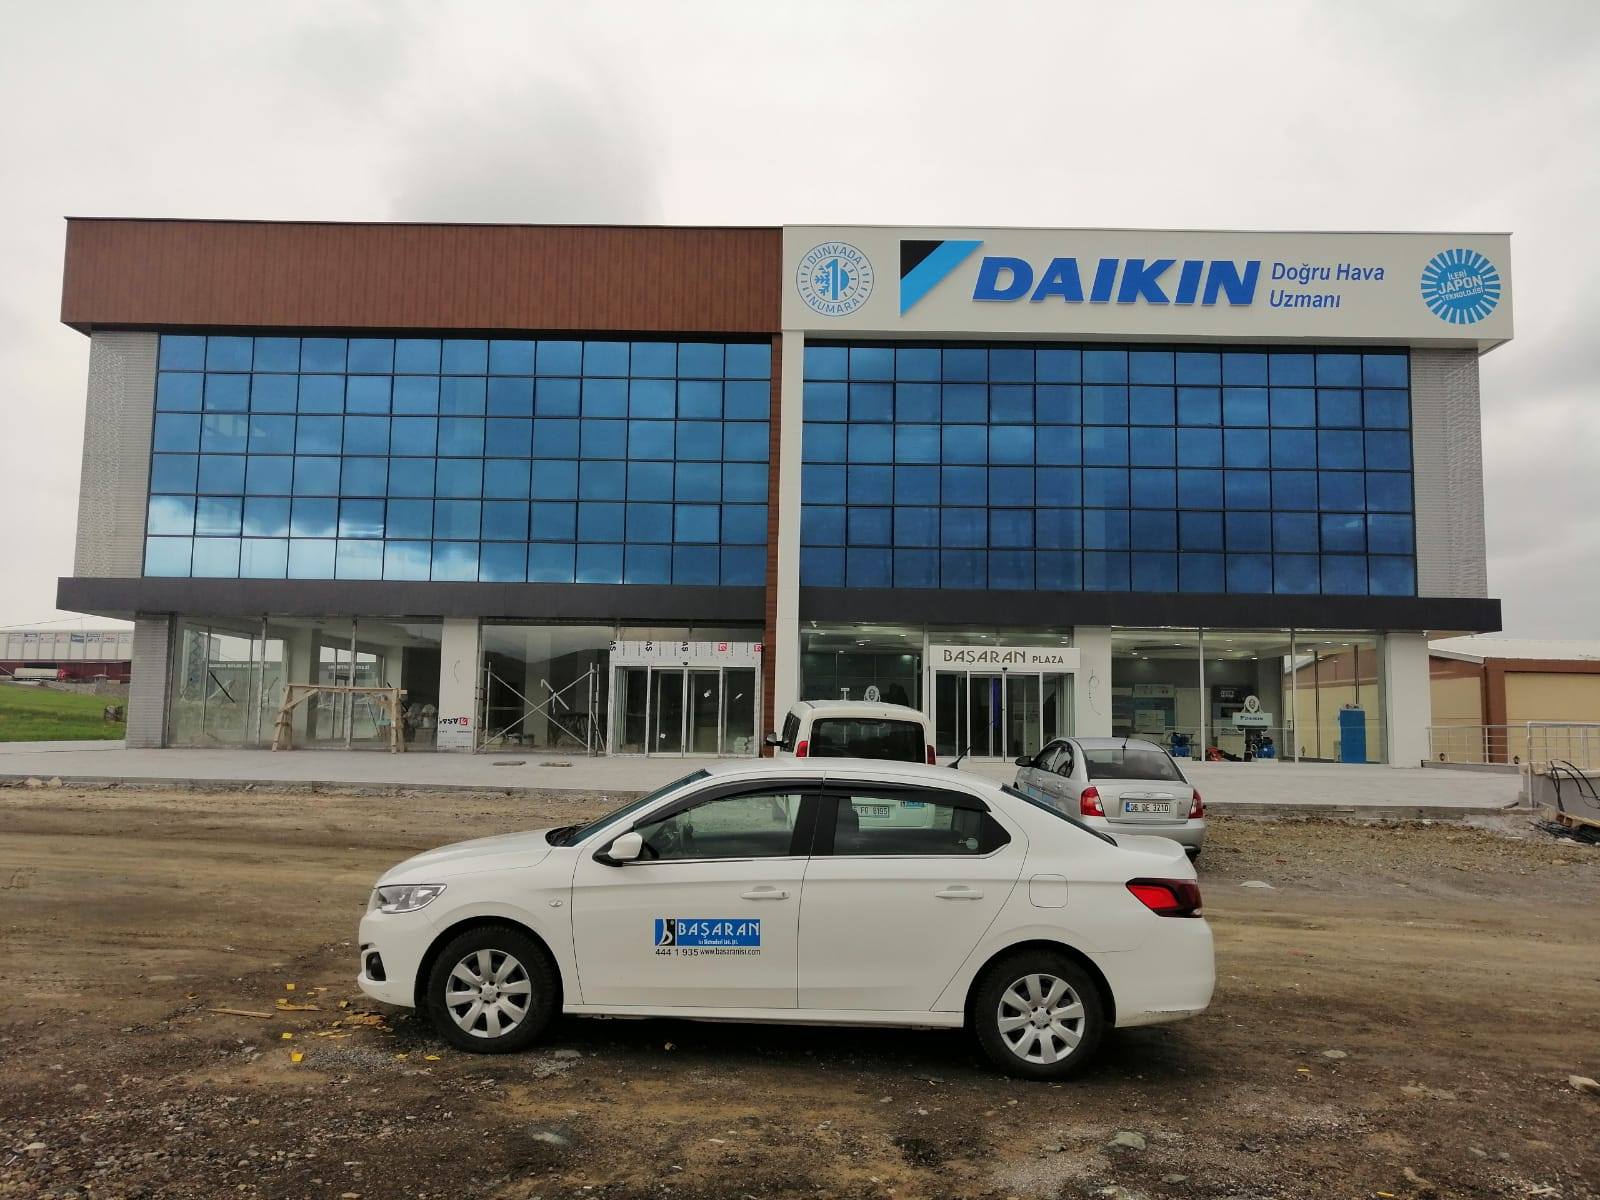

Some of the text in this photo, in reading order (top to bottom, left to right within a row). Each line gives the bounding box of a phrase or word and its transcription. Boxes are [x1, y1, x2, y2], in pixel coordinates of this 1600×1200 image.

[972, 256, 1261, 306] DAIKIN
[1271, 262, 1385, 285] Doğru Hava
[1438, 275, 1483, 295] JAPON
[808, 296, 860, 314] NUMARA
[1269, 289, 1341, 308] Uzmanı
[943, 649, 1065, 665] BAŞARAN PLAZA
[678, 922, 760, 939] BAŞARAN
[655, 948, 672, 956] 444
[682, 948, 699, 957] 935
